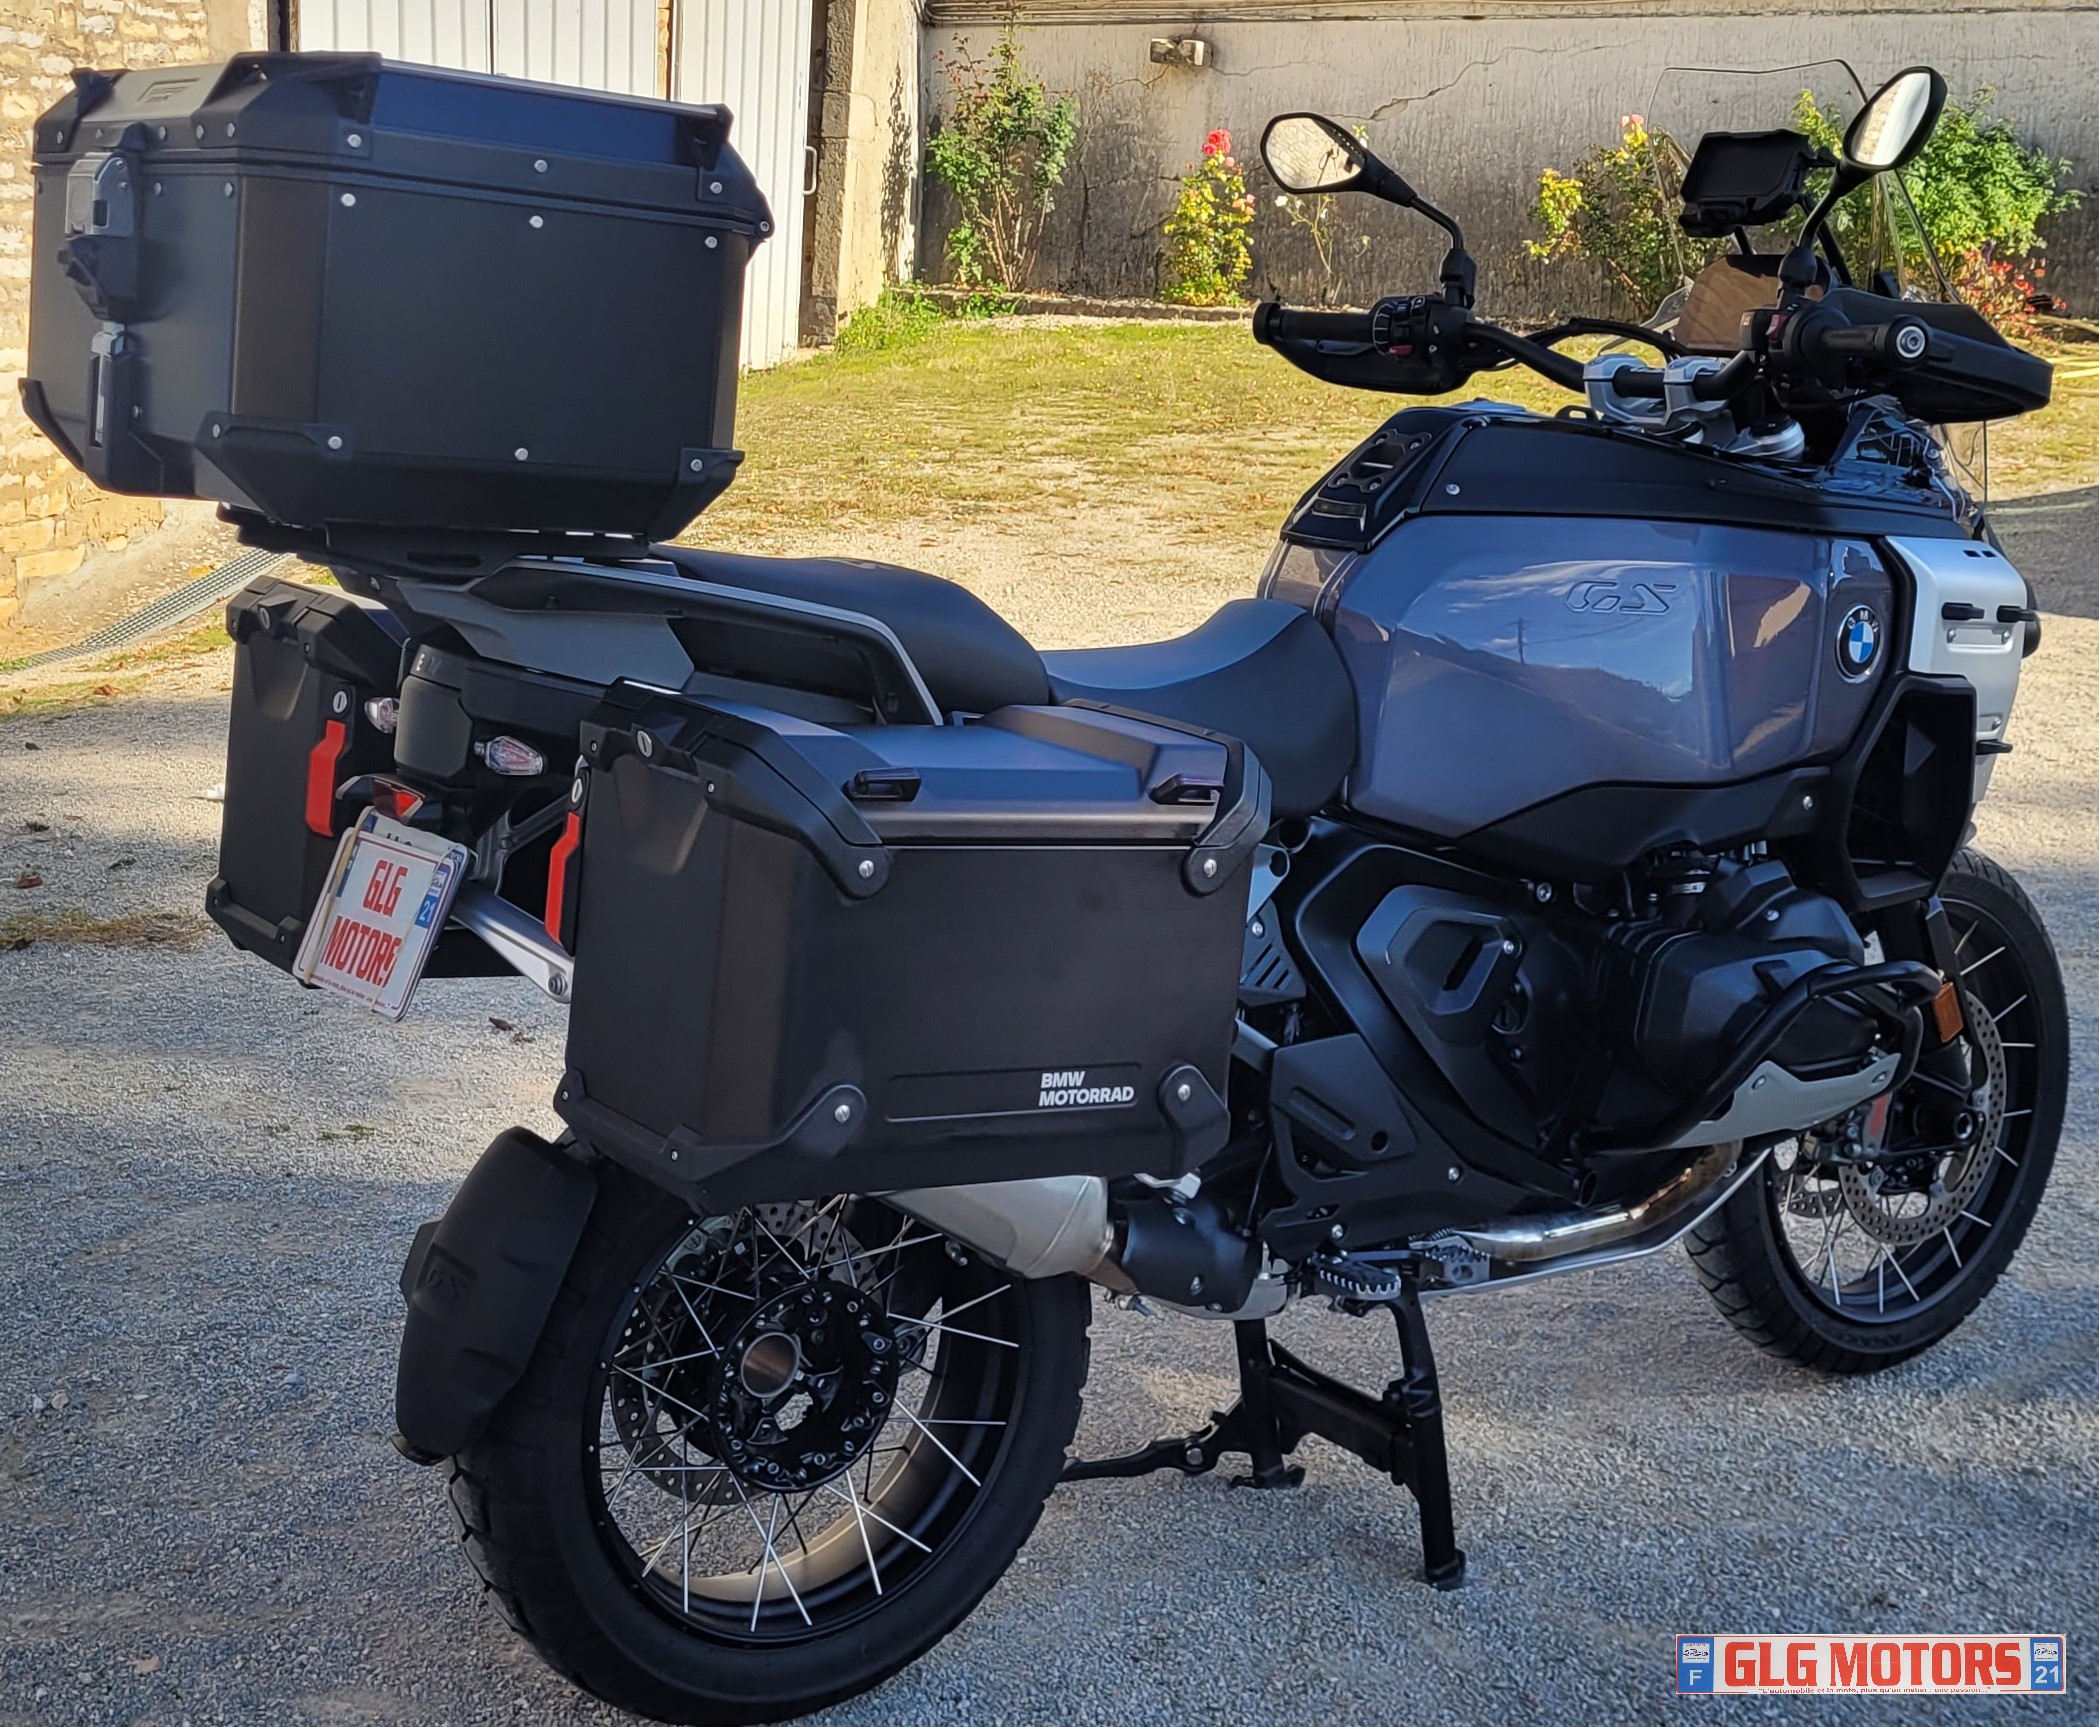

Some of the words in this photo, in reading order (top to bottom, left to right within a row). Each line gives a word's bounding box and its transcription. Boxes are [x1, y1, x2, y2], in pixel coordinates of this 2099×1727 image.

[1565, 580, 1676, 615] GS
[1847, 609, 1879, 632] BMW
[362, 859, 408, 917] GLG
[419, 899, 436, 924] 21
[320, 915, 402, 988] MOTORS
[1041, 1071, 1086, 1089] BMW
[1038, 1086, 1135, 1107] MOTORRAD
